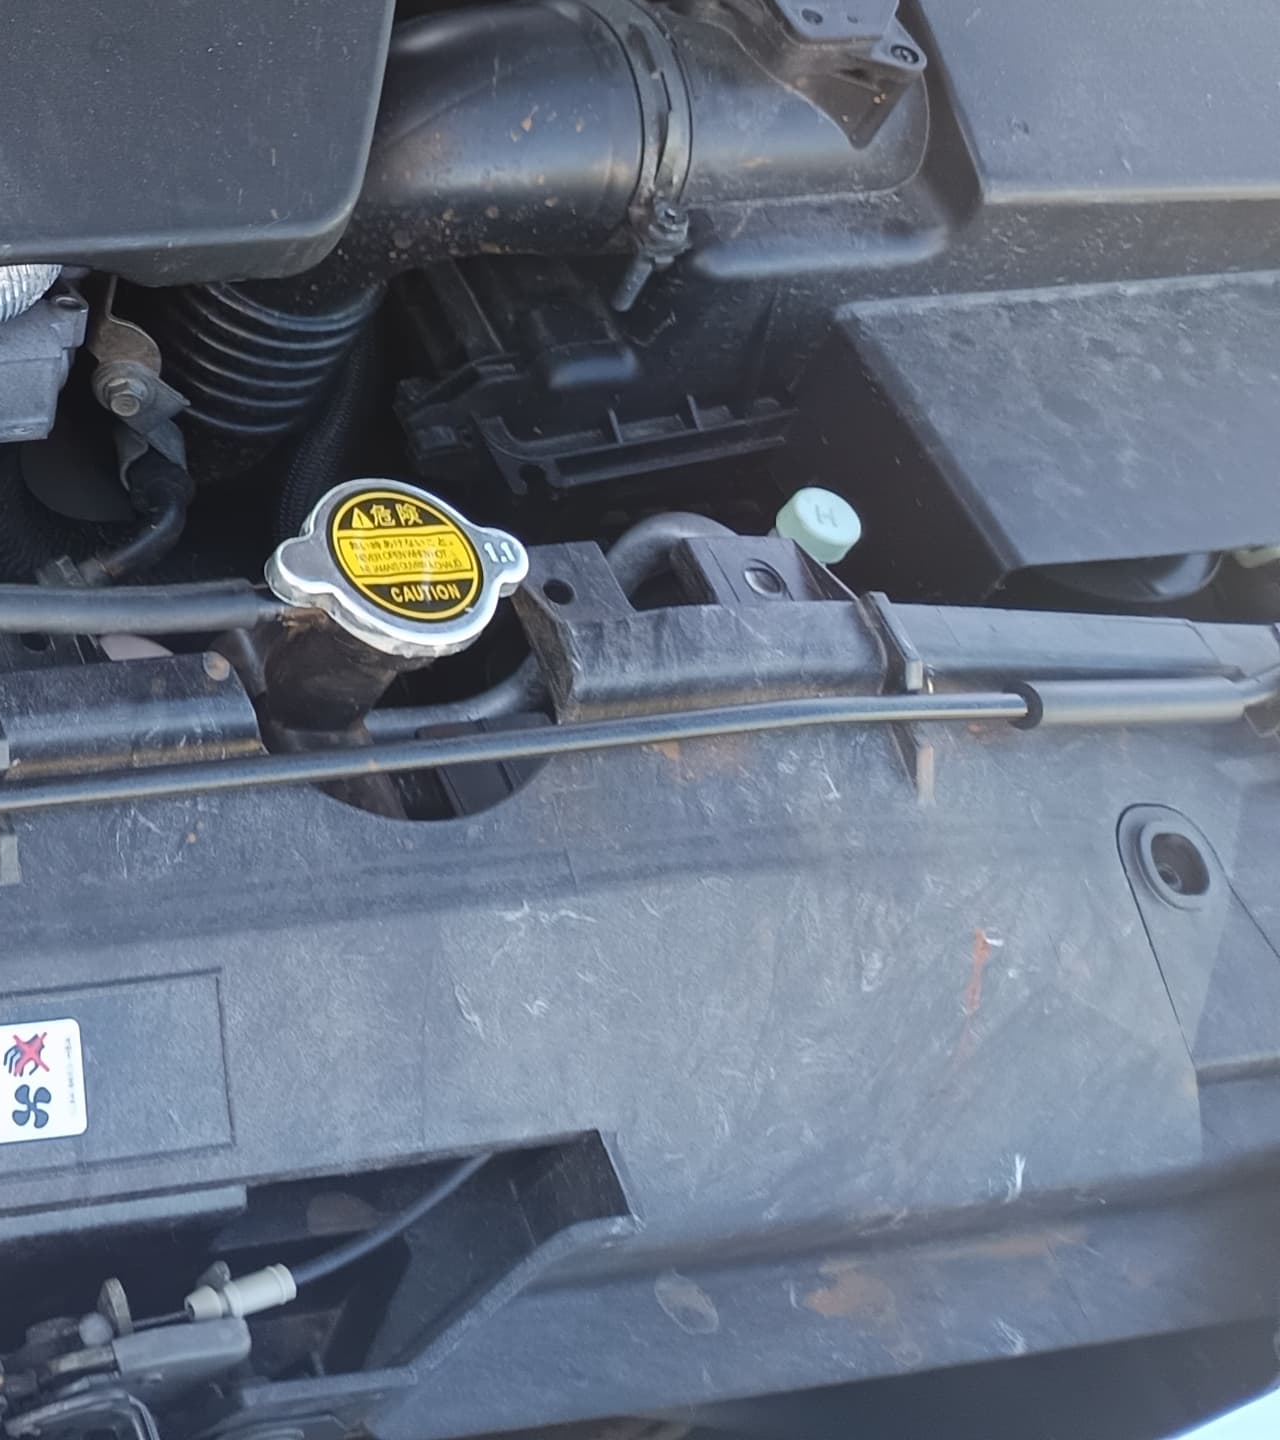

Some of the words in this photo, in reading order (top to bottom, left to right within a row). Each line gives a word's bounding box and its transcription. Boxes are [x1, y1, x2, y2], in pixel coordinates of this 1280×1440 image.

[370, 503, 423, 527] 危険
[483, 541, 517, 564] 1.1
[390, 583, 462, 604] CAUTION
